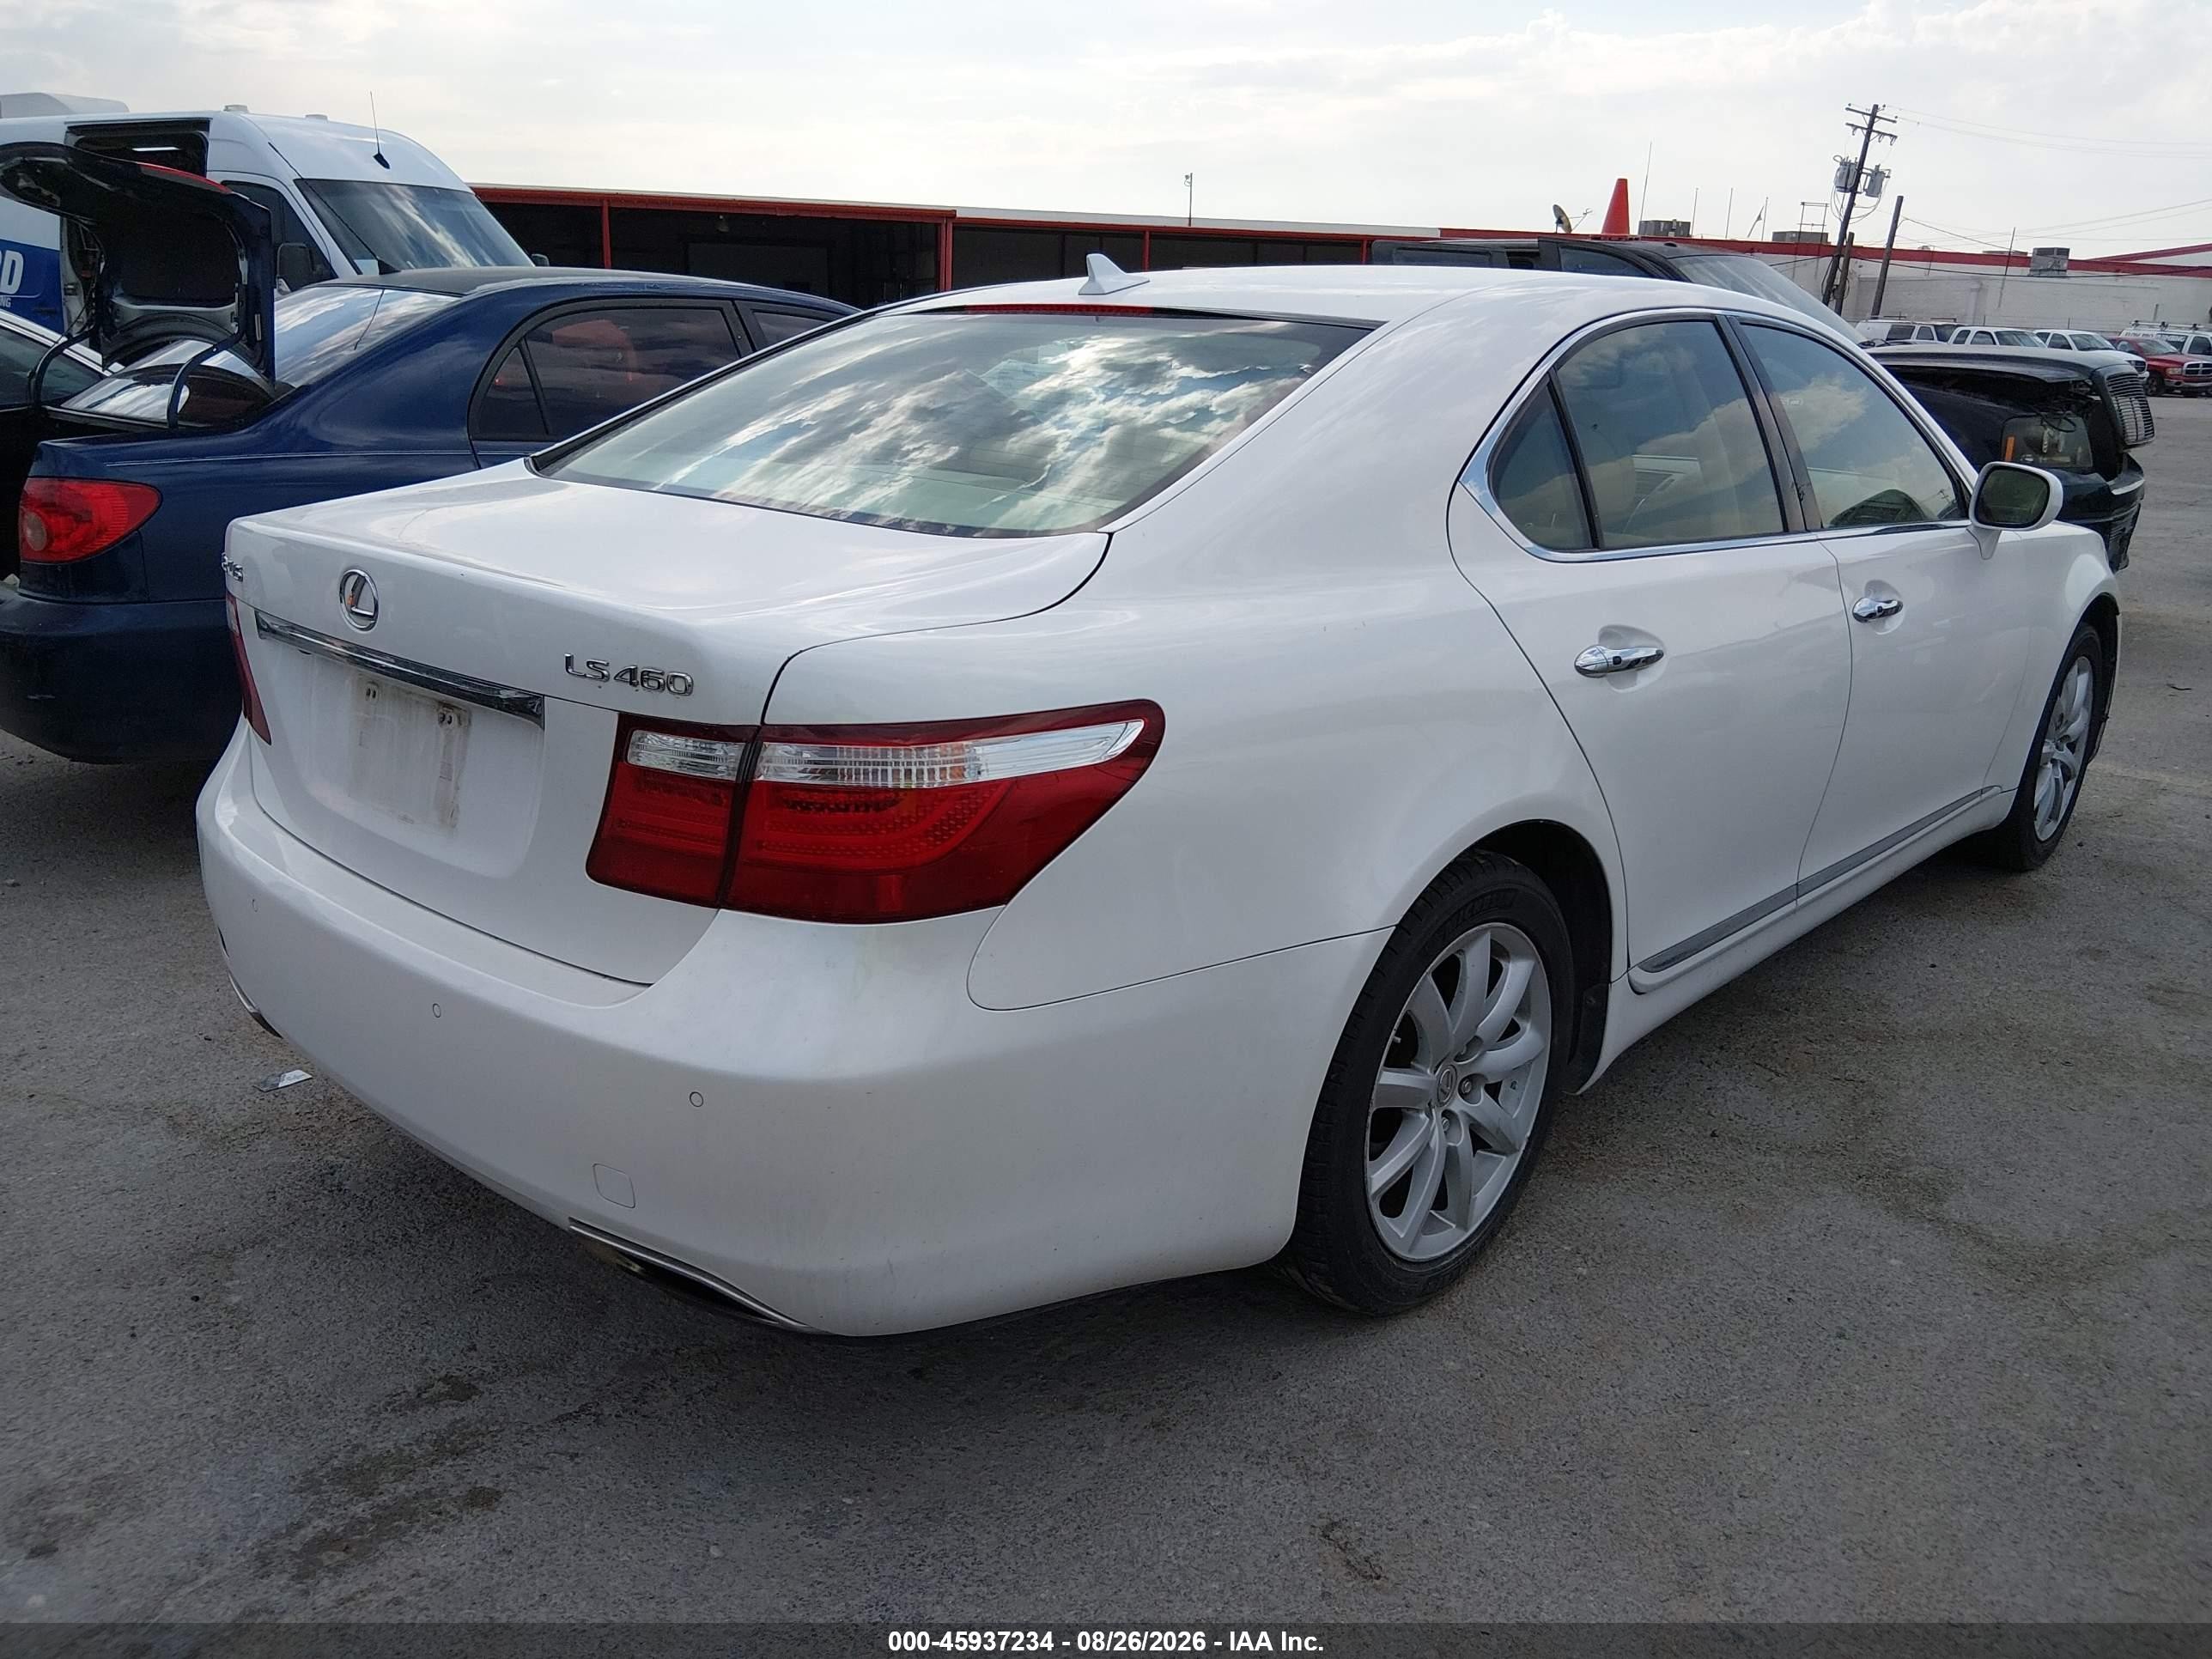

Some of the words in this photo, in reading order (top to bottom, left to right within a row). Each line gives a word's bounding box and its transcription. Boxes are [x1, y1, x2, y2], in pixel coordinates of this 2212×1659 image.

[0, 249, 24, 295] D
[564, 653, 610, 683] LS
[614, 665, 694, 696] 460
